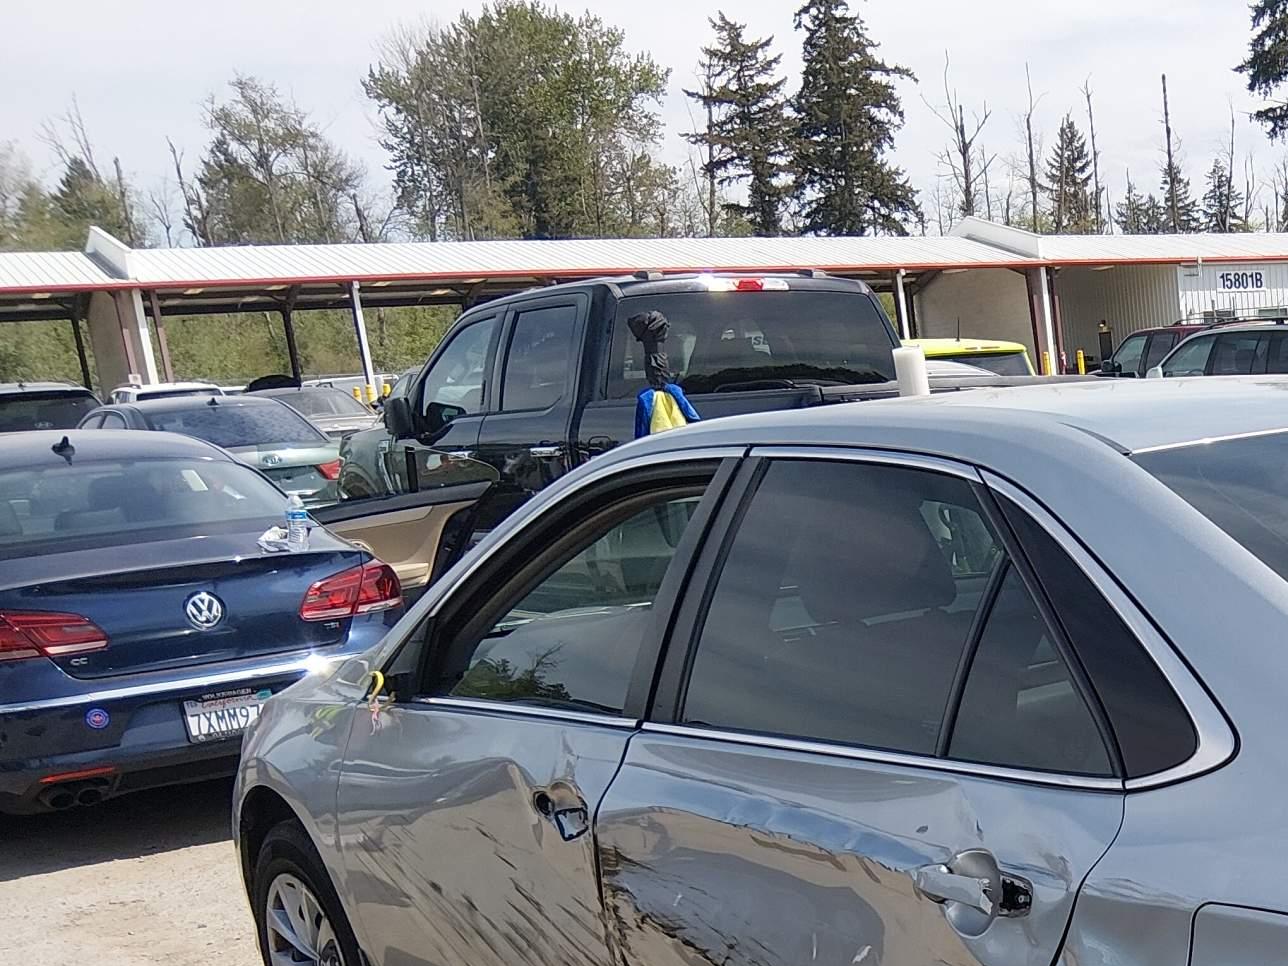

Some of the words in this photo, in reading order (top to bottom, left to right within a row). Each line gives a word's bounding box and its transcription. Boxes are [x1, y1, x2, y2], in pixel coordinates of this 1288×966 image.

[1219, 272, 1263, 289] 15801B
[70, 657, 88, 666] CC
[190, 704, 260, 736] 7XMM97
